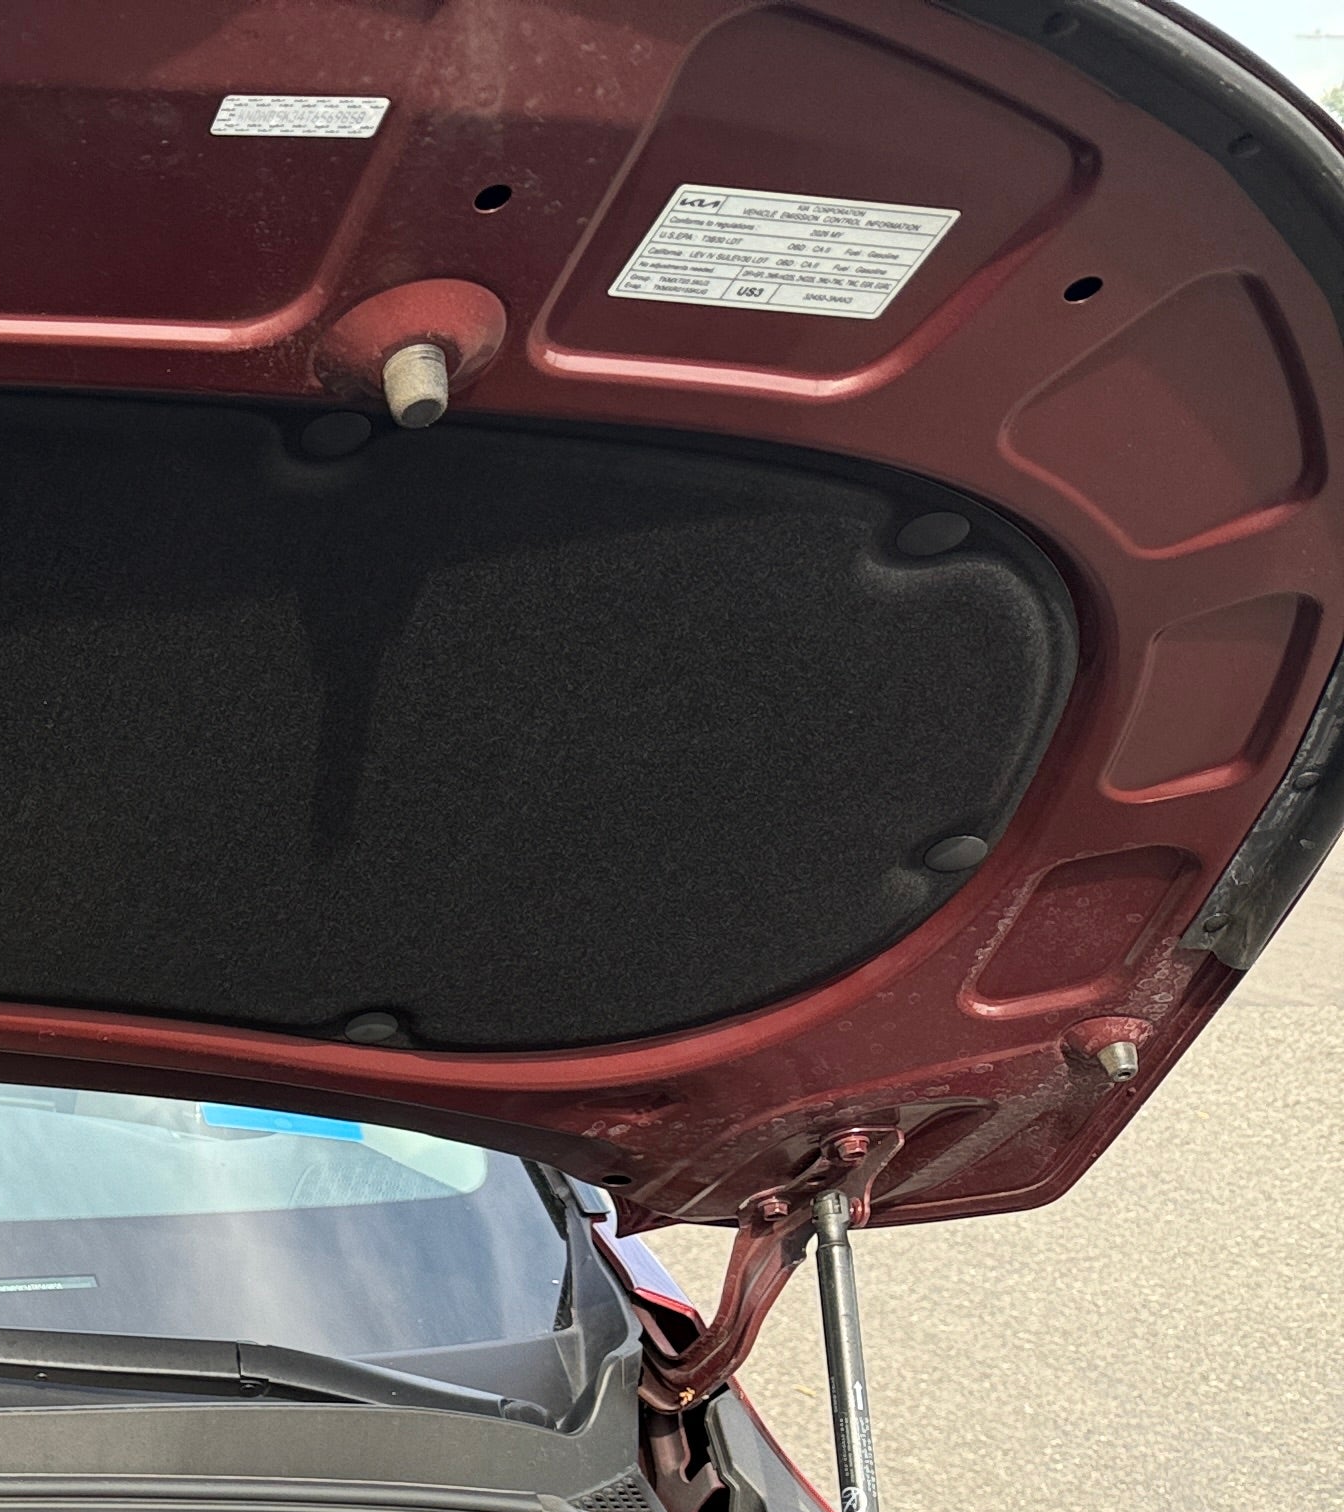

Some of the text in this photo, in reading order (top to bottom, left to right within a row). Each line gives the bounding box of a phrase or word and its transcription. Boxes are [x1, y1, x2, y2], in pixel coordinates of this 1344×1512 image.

[812, 206, 866, 217] CORPORATION
[670, 216, 705, 227] Conforms
[742, 208, 921, 232] VEHICLE EMISSION CONTROL INFORMATION
[736, 286, 764, 298] US3
